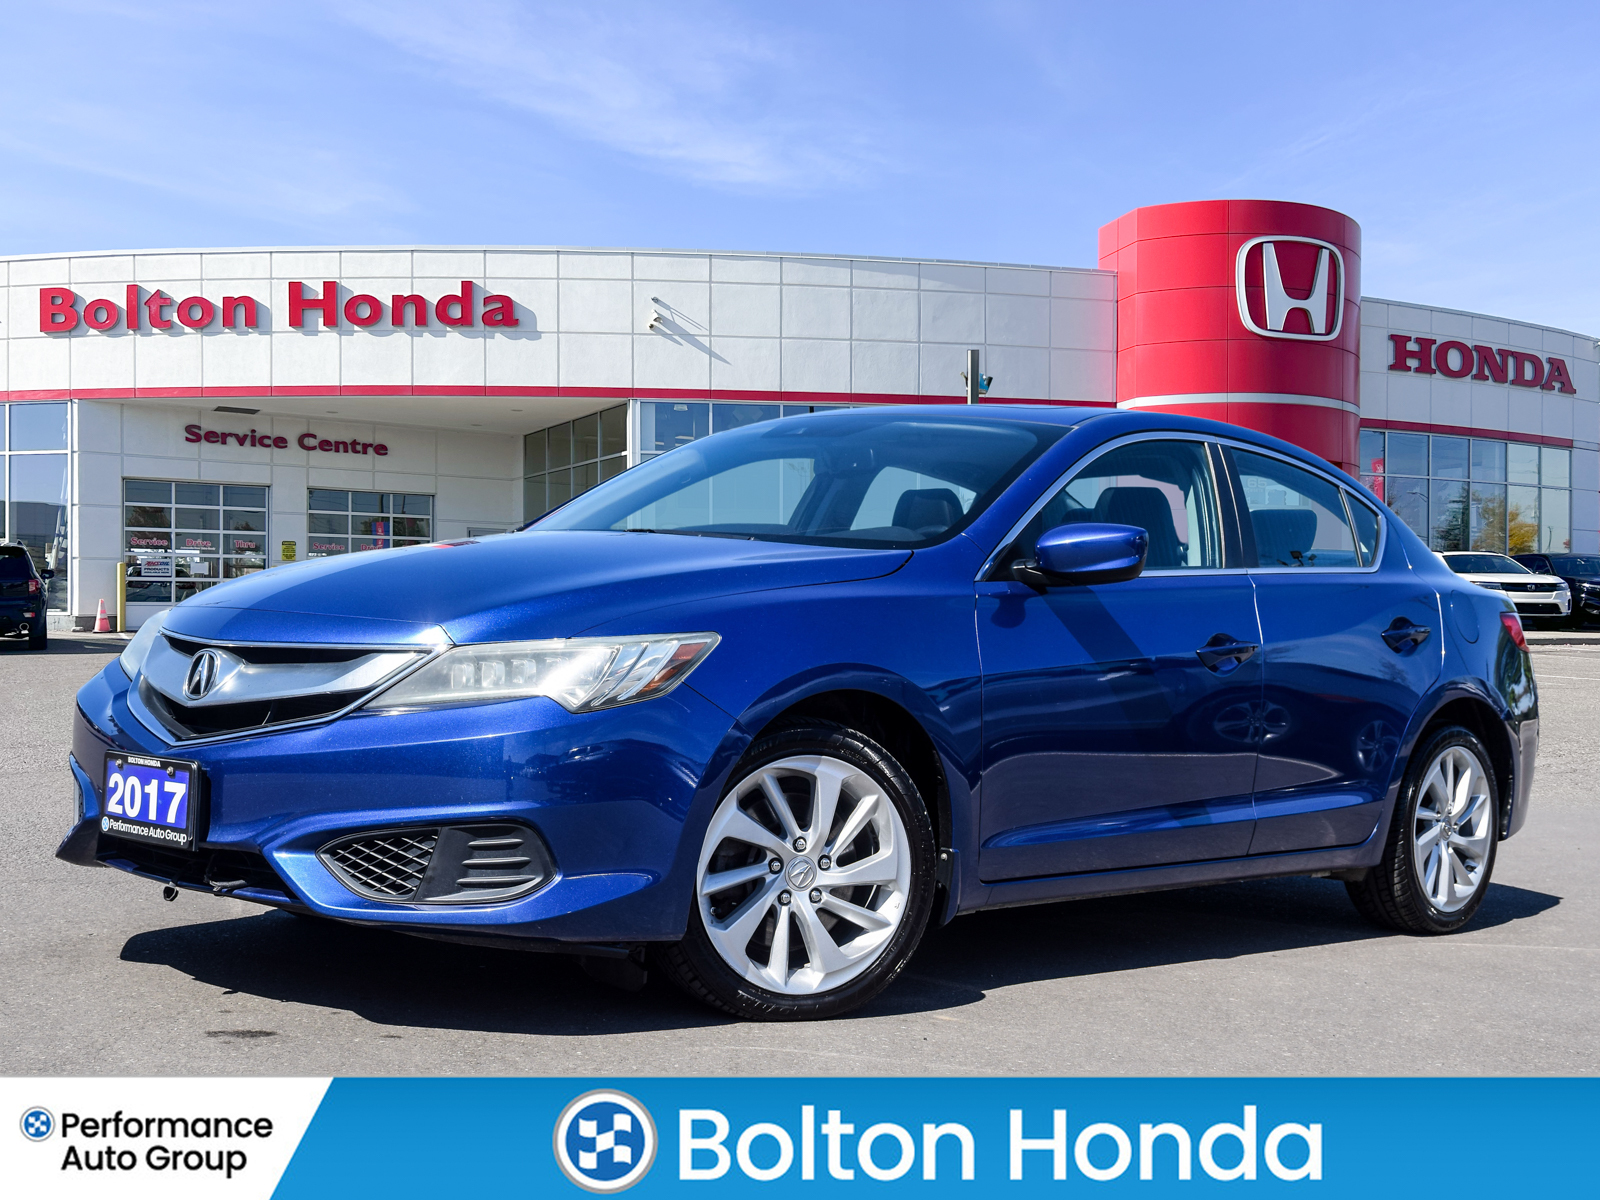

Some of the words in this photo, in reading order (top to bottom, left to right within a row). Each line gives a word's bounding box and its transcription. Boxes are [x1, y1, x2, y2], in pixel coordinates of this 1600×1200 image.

[40, 284, 257, 332] Bolton
[288, 280, 519, 328] Honda
[1388, 334, 1577, 394] HONDA
[184, 424, 288, 449] Service
[297, 433, 389, 456] Centre
[130, 537, 168, 546] Service
[186, 538, 211, 547] Drive
[234, 540, 256, 549] Thru
[313, 542, 345, 550] Service
[127, 756, 145, 765] BOLTON
[145, 759, 161, 767] HONDA
[107, 772, 186, 824] 2017
[109, 819, 149, 835] Performance
[149, 827, 165, 838] Auto
[165, 831, 187, 845] Group
